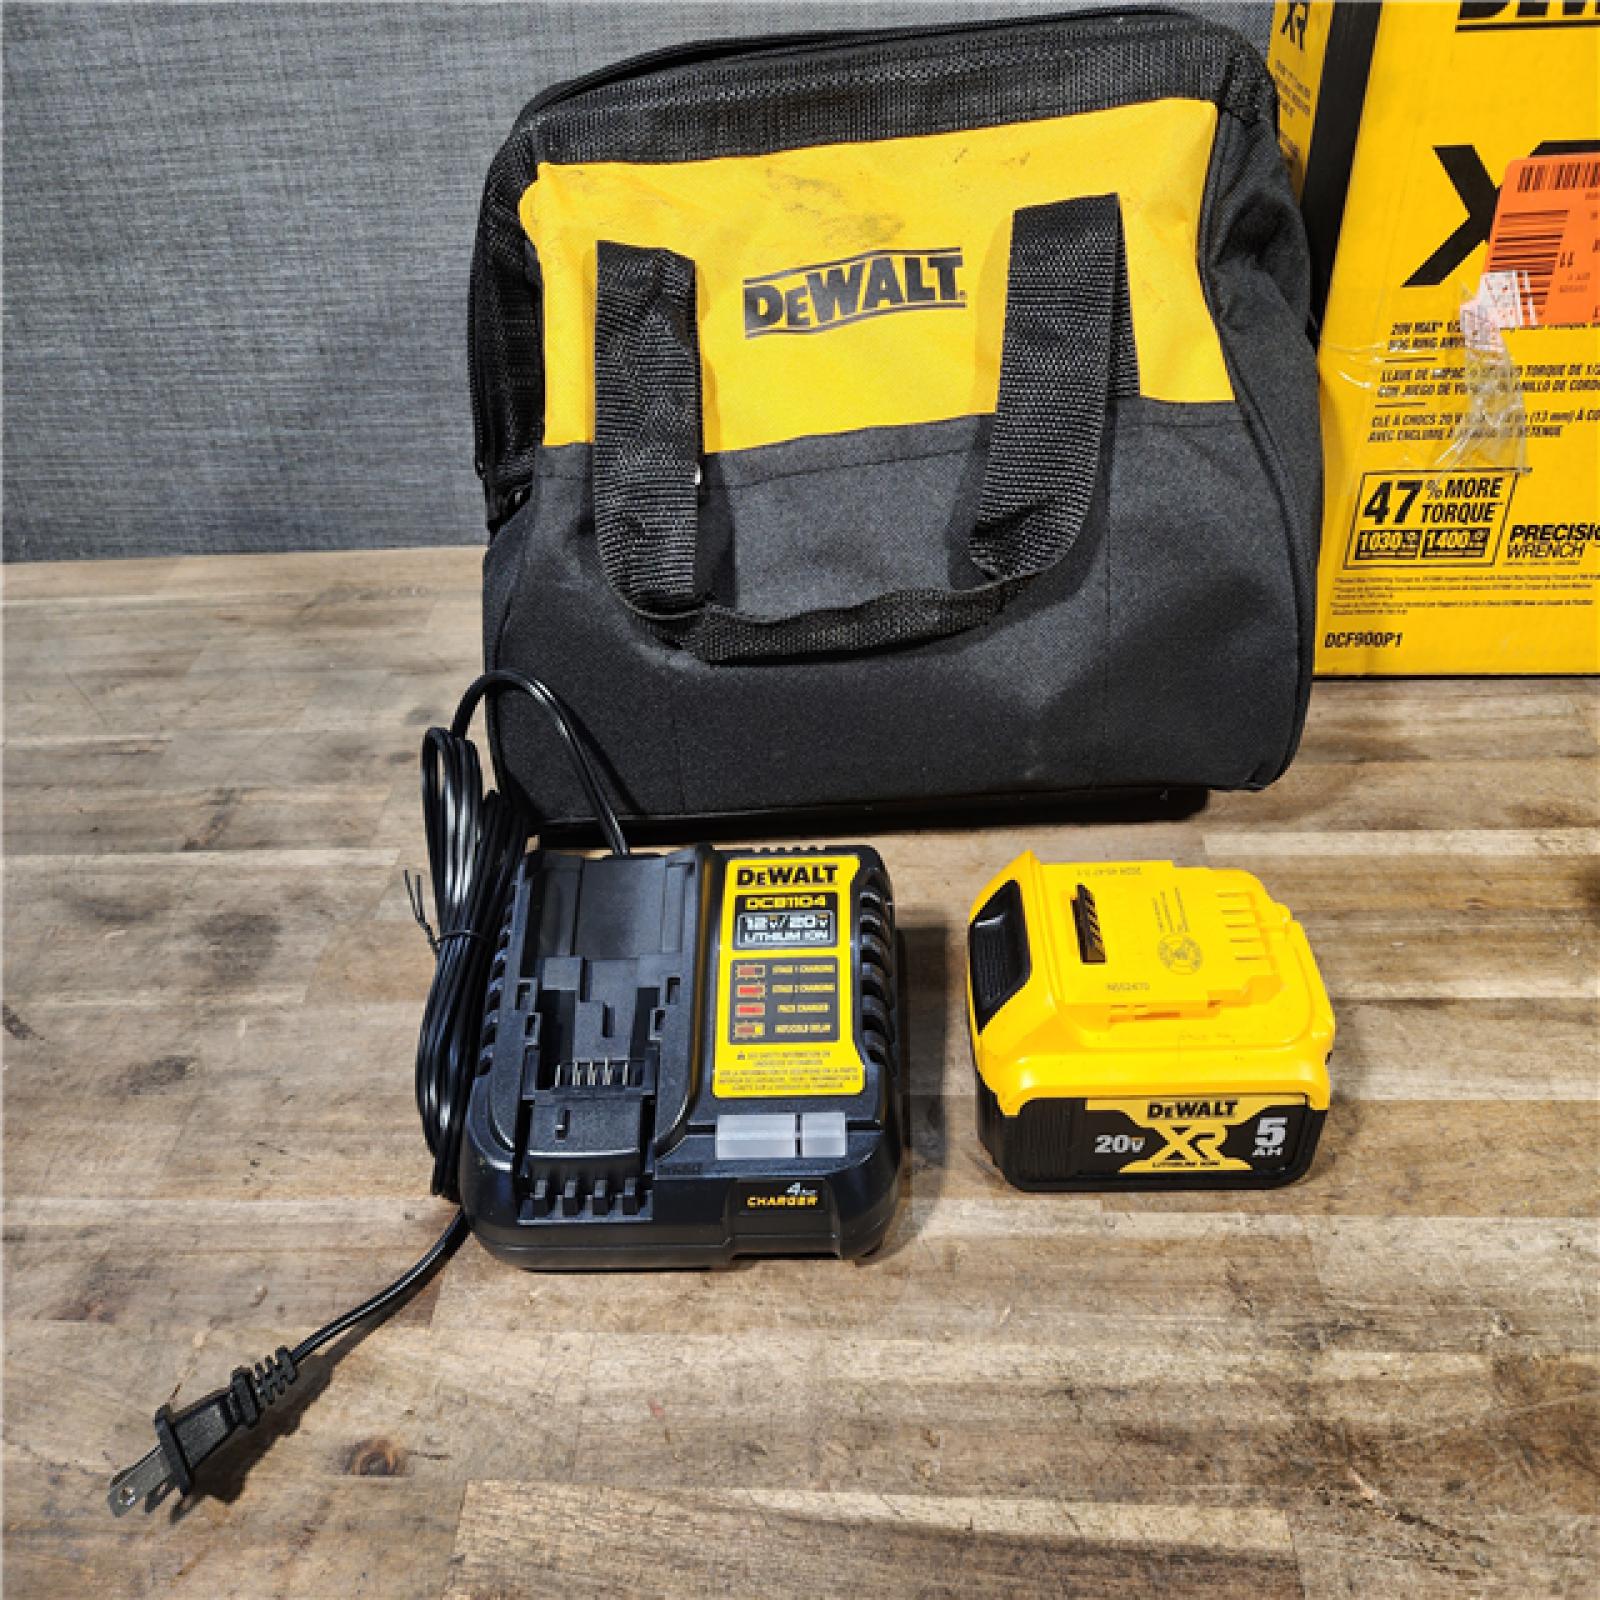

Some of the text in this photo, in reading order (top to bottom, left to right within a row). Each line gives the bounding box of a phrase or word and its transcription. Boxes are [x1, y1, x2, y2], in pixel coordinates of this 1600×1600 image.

[1412, 337, 1438, 349] RING
[1415, 369, 1429, 381] DE
[1525, 364, 1564, 377] TORQUE
[1568, 364, 1582, 376] DE
[1402, 384, 1435, 396] JUEGO
[1437, 383, 1450, 395] DE
[1552, 380, 1566, 391] DE
[1403, 414, 1436, 426] CHOCS
[1368, 430, 1394, 442] AVEC
[1445, 477, 1503, 499] MORE
[1420, 503, 1496, 525] TORQUE
[1427, 529, 1470, 549] 1400
[1507, 543, 1586, 558] WRENCH
[1324, 632, 1404, 648] DCF900P1
[746, 895, 826, 910] DCB1104
[744, 929, 829, 943] LITHIUM ION
[1255, 1118, 1289, 1146] 5
[786, 1182, 801, 1195] 4
[747, 1195, 818, 1207] CHARGER
